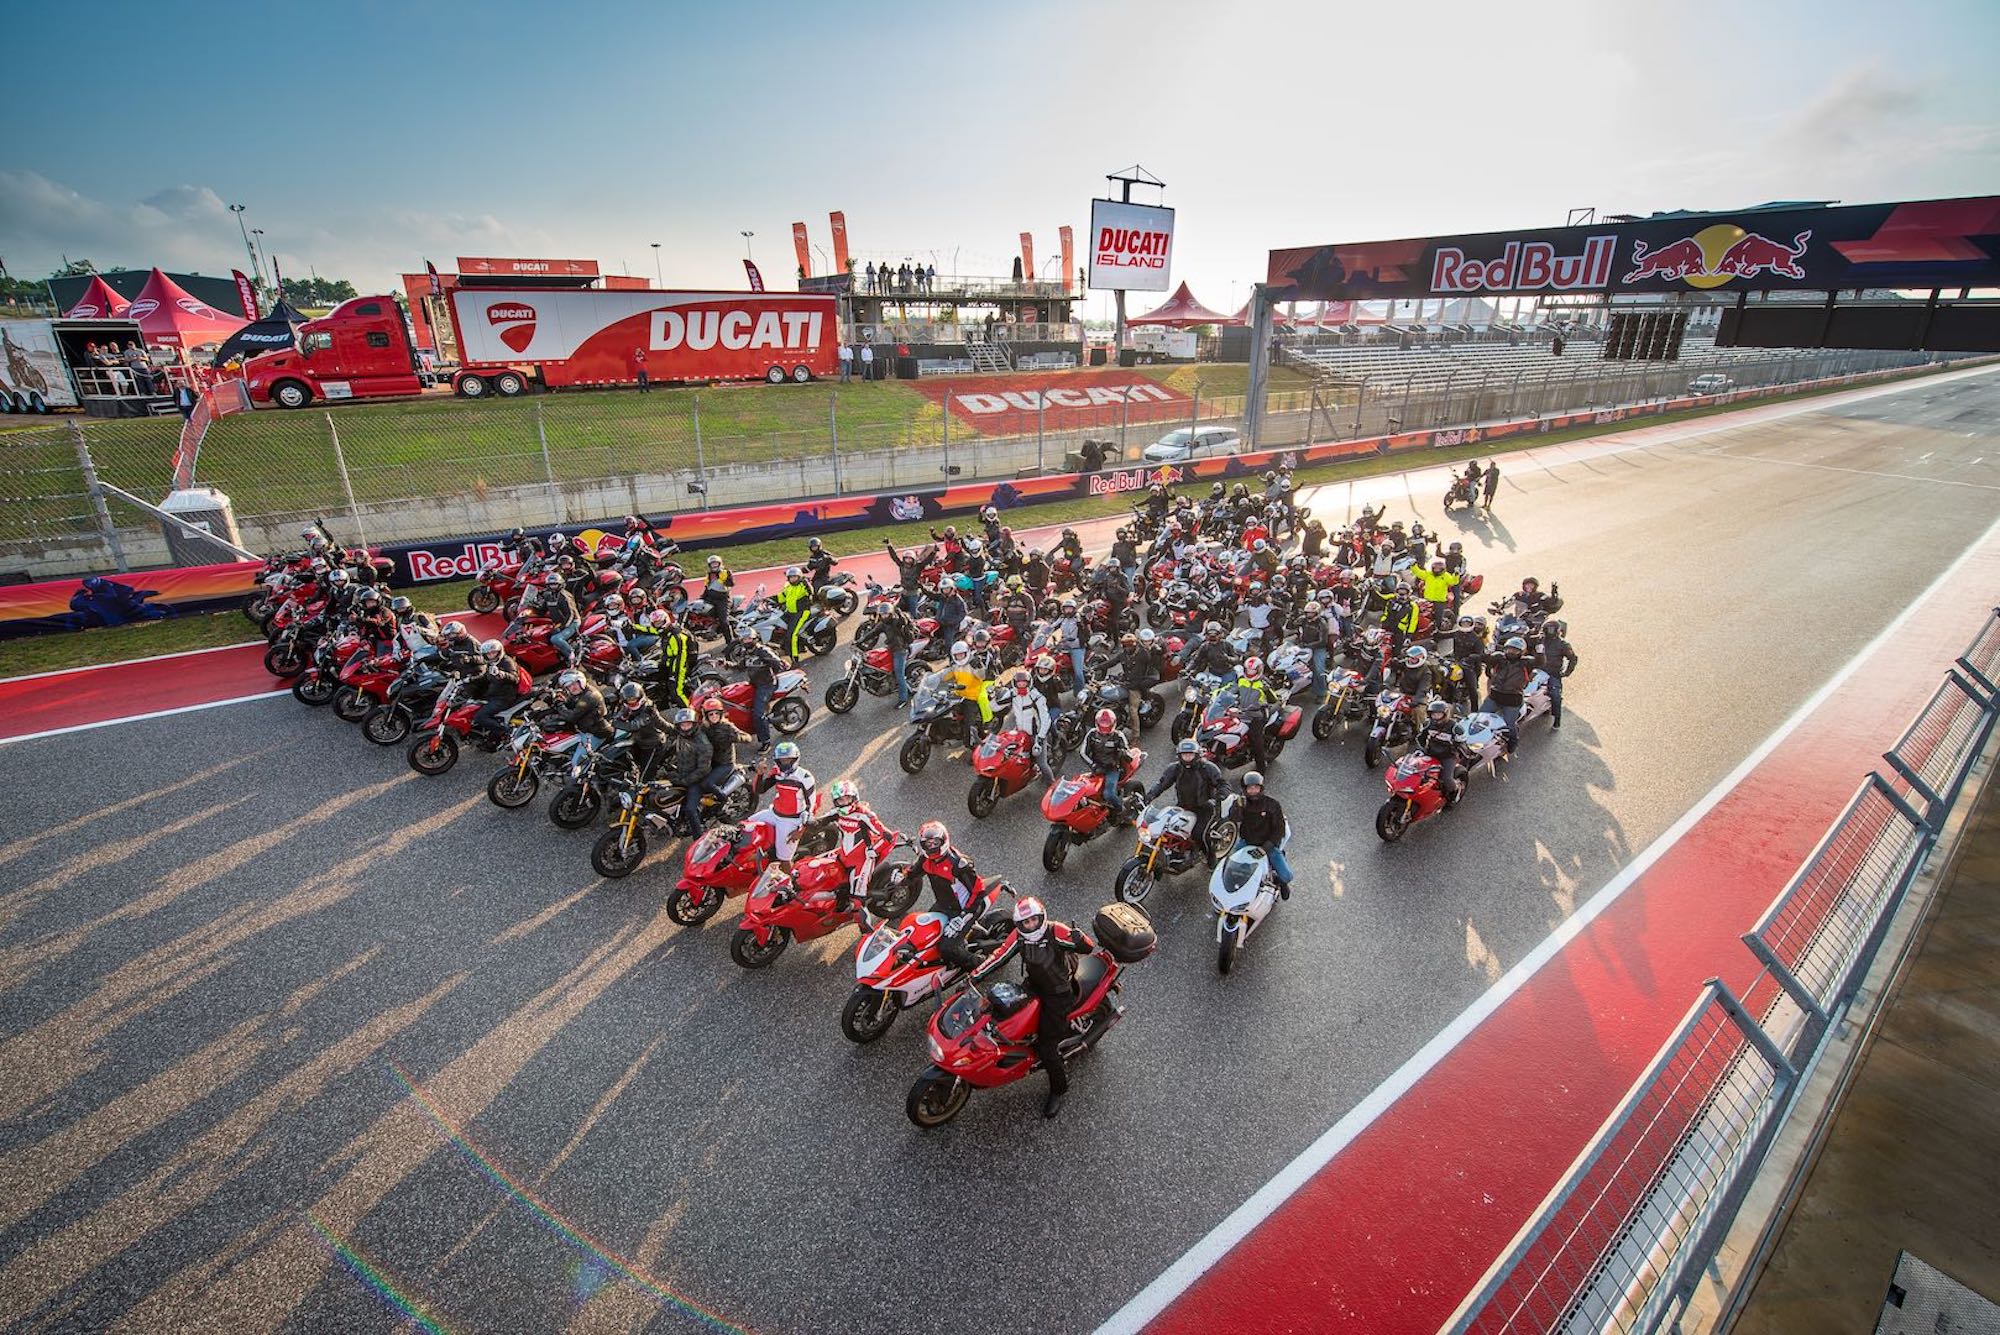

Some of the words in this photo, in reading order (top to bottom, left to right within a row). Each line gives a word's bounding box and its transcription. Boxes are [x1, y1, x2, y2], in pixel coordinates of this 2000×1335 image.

[1098, 227, 1169, 256] DUCATI
[512, 262, 549, 272] DUCATI
[1096, 253, 1165, 268] ISLAND
[1430, 241, 1521, 292] Red
[1516, 235, 1618, 290] Bull
[490, 308, 533, 320] DUCATI
[240, 333, 291, 342] DUCATI
[649, 310, 823, 351] DUCATI
[955, 384, 1174, 414] DUCATI
[1090, 472, 1118, 496] Red
[1118, 469, 1145, 492] Bull
[407, 543, 480, 582] Red
[477, 542, 522, 571] Bu
